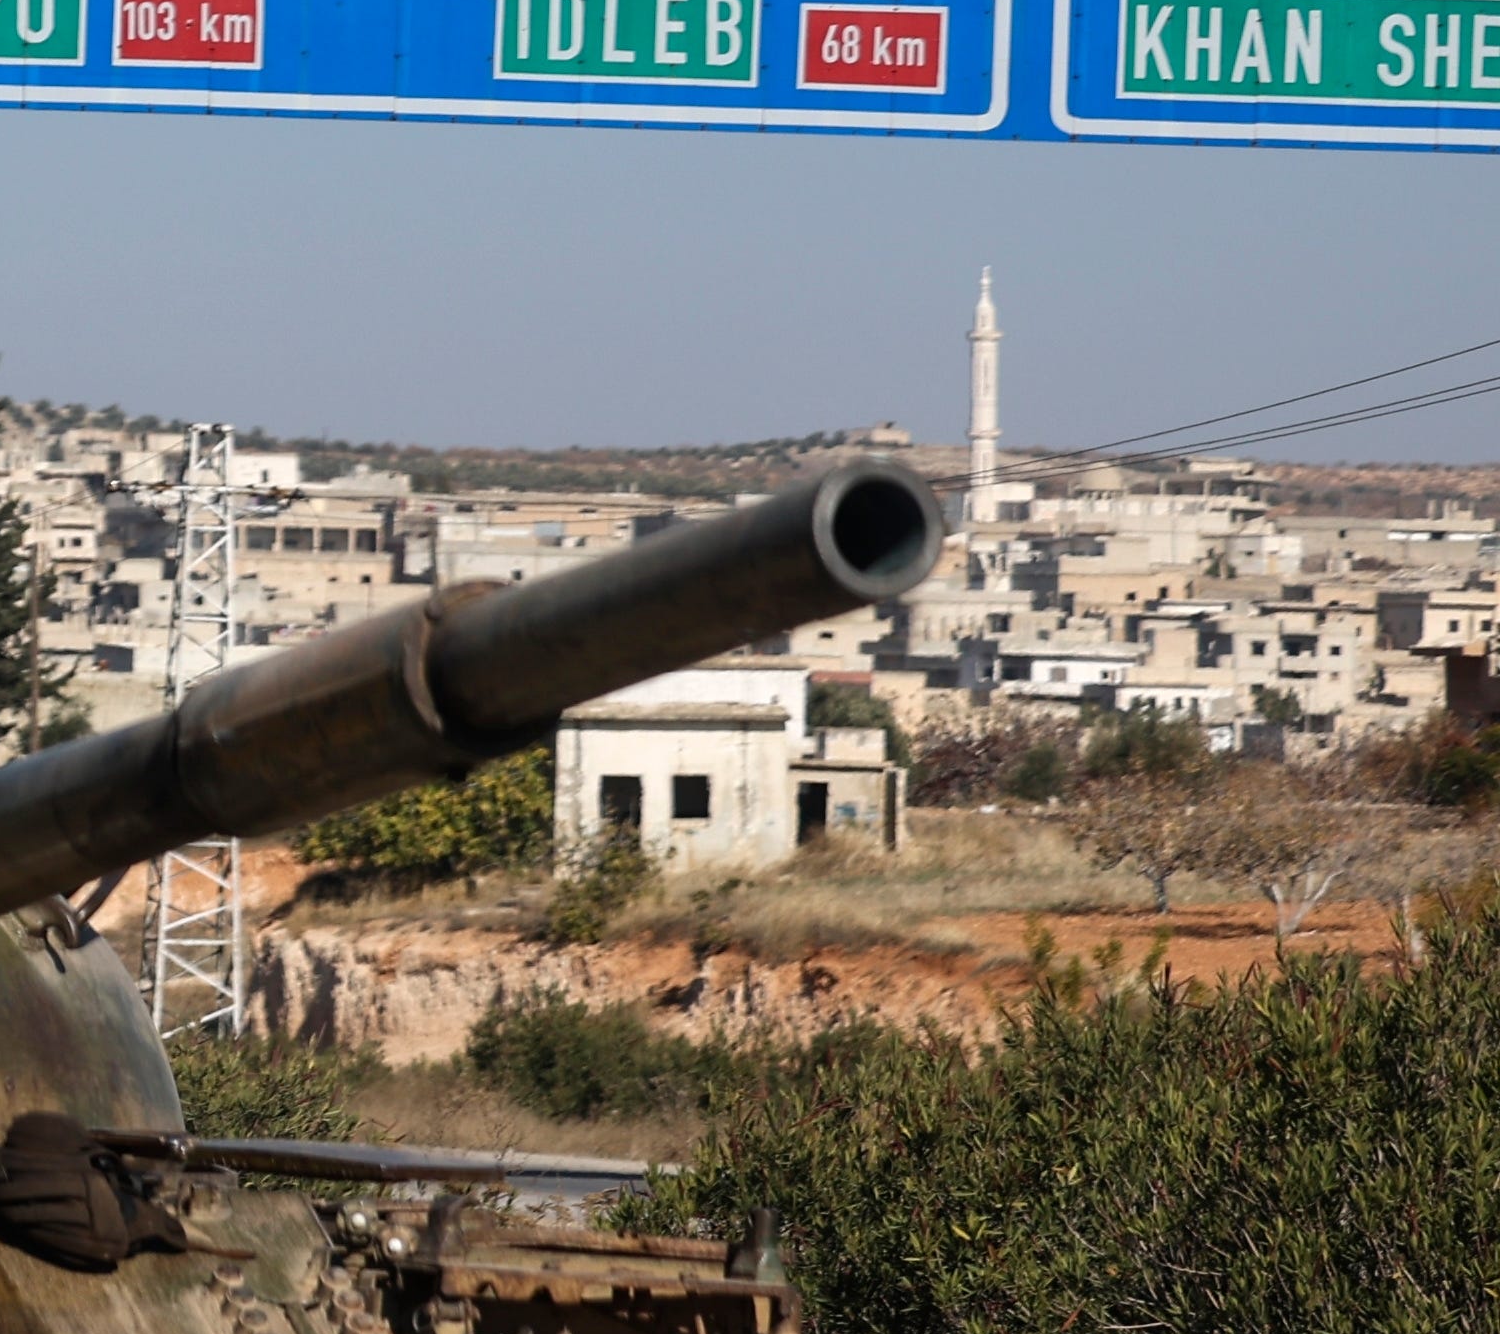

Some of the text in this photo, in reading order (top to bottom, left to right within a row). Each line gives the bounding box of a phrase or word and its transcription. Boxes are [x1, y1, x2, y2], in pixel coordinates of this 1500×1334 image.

[122, 0, 254, 44] 103 km
[1133, 3, 1322, 85] KHAN
[821, 23, 926, 67] 68 km
